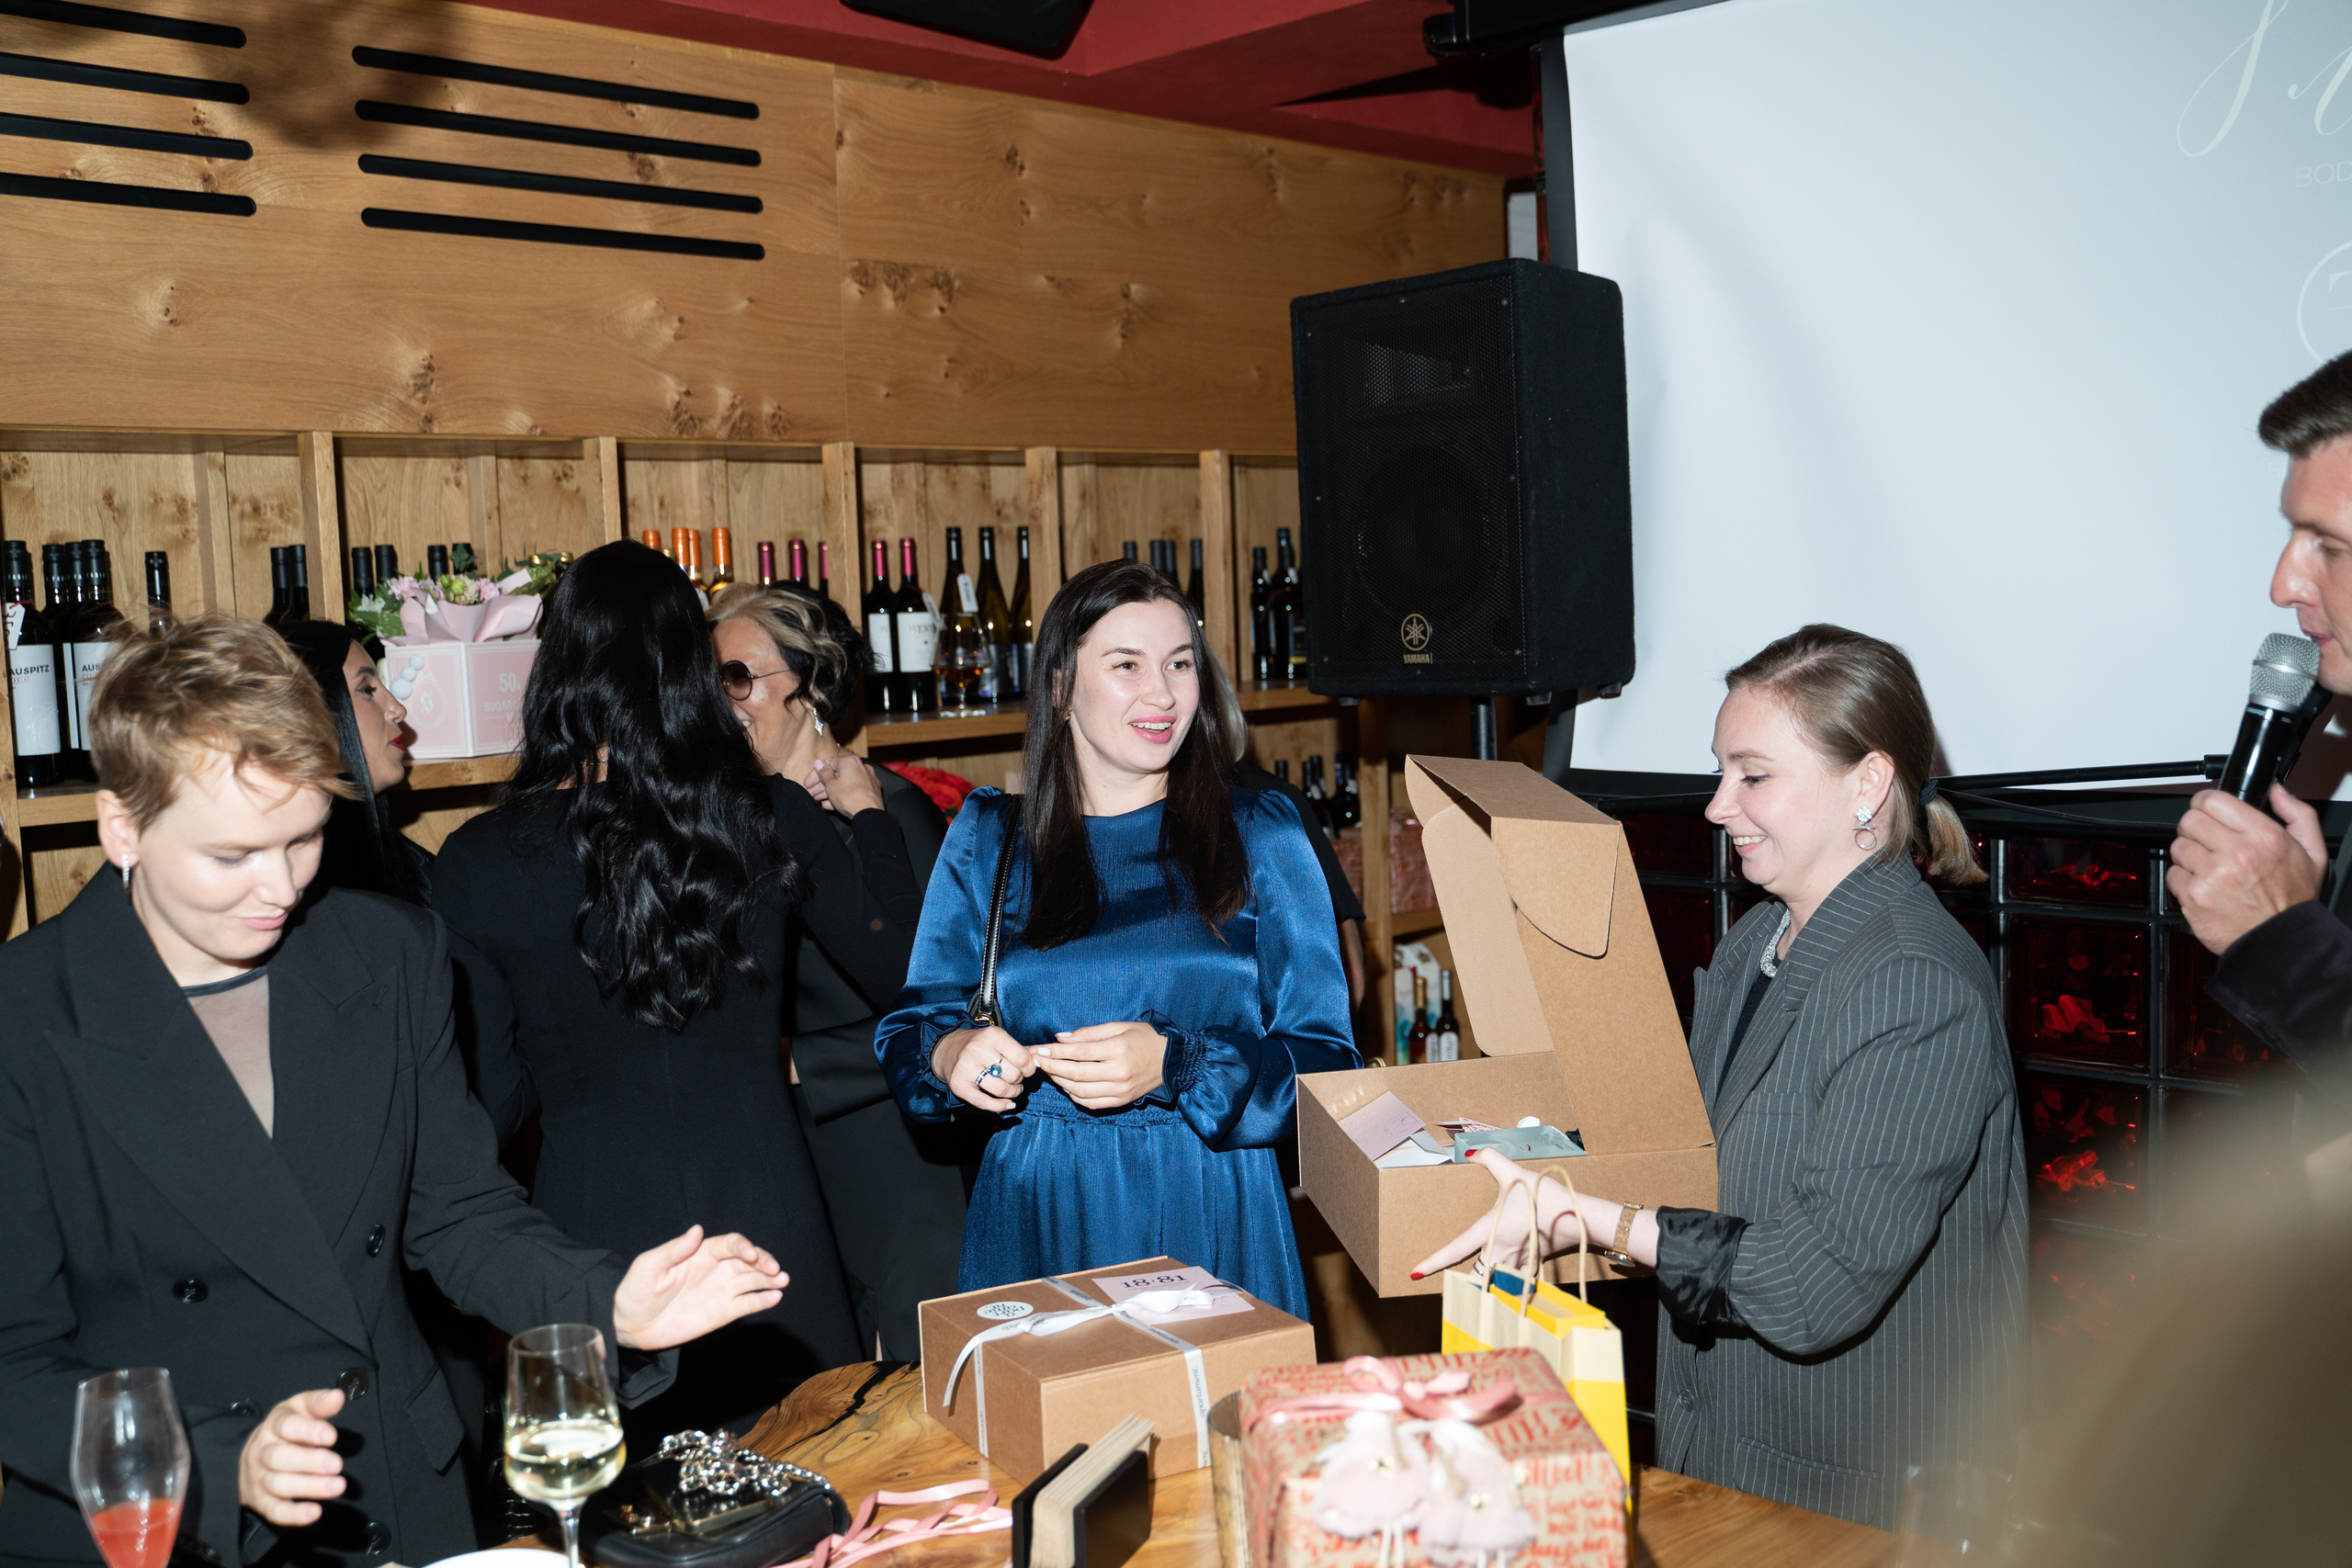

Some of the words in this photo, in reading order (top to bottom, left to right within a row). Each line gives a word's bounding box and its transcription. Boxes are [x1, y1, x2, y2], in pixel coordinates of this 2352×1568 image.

[1402, 652, 1430, 664] YAMAHA
[9, 664, 51, 676] AUSPITZ
[483, 700, 513, 713] SUGAR
[1192, 1365, 1206, 1417] apartament.
